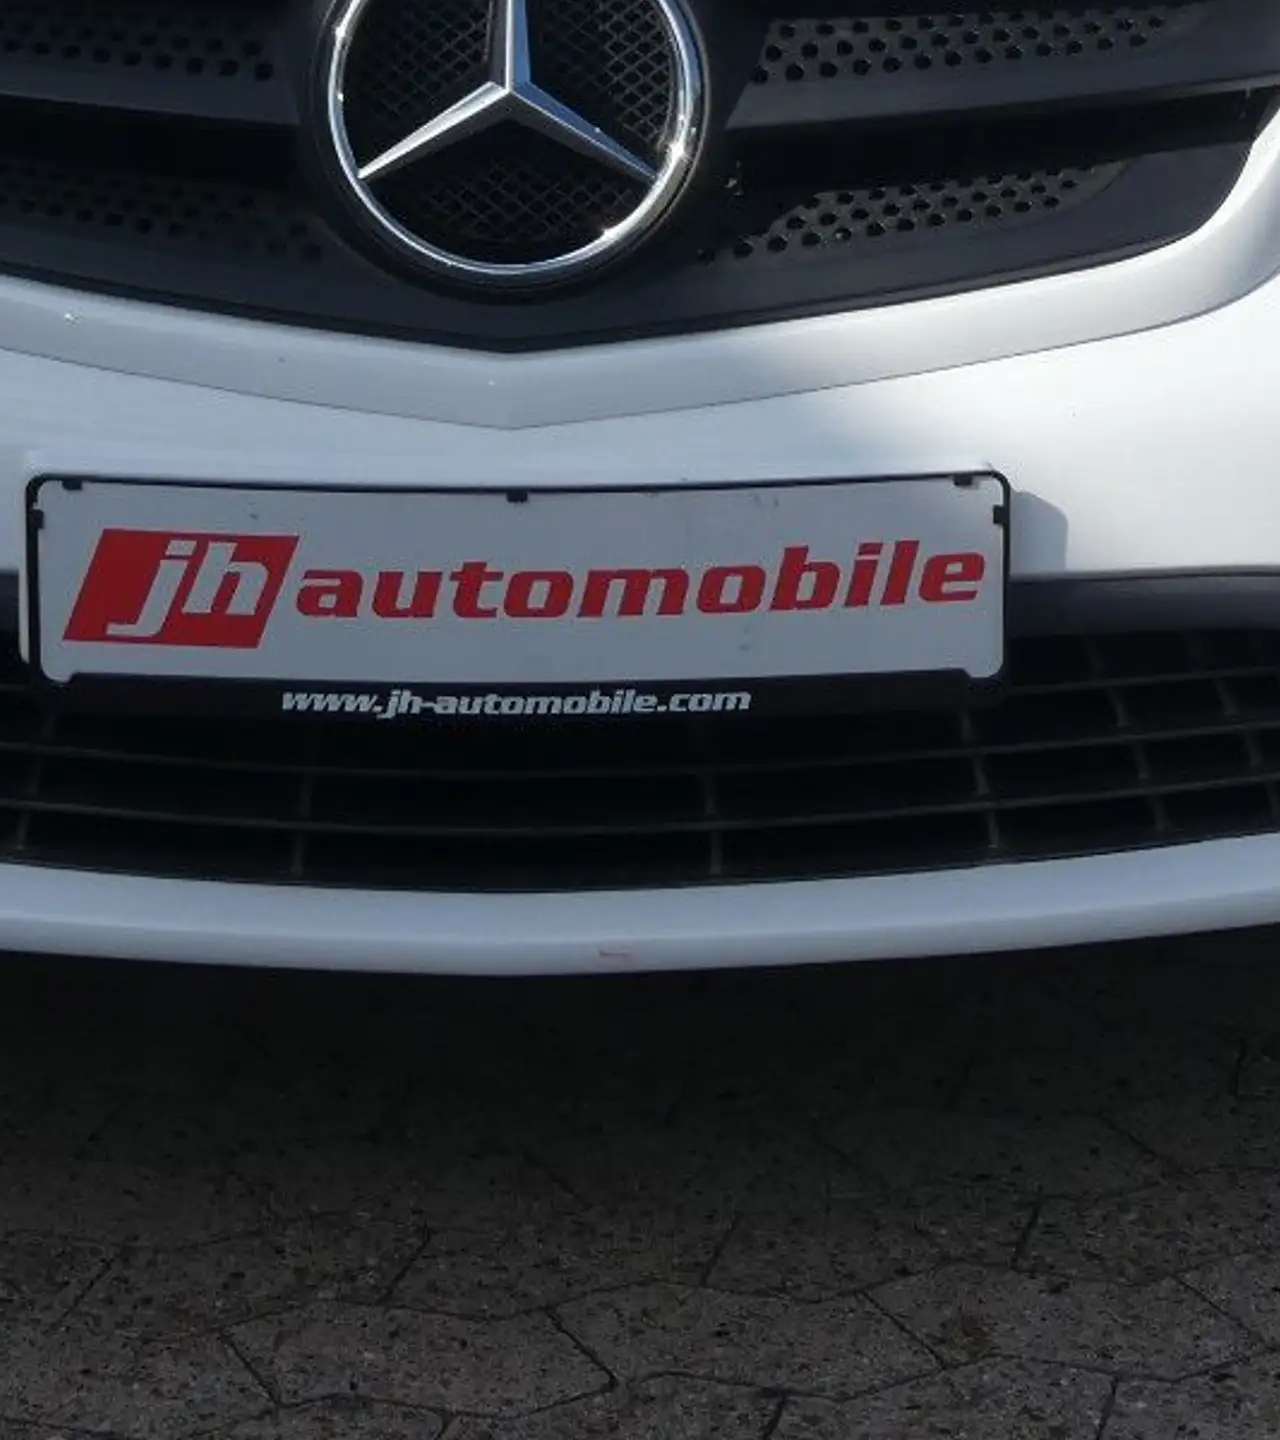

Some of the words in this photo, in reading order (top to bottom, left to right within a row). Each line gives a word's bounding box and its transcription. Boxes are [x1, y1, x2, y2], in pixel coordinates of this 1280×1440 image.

[105, 538, 271, 638] jh
[296, 539, 986, 619] automobile
[282, 689, 752, 720] www.jh-automobile.com
